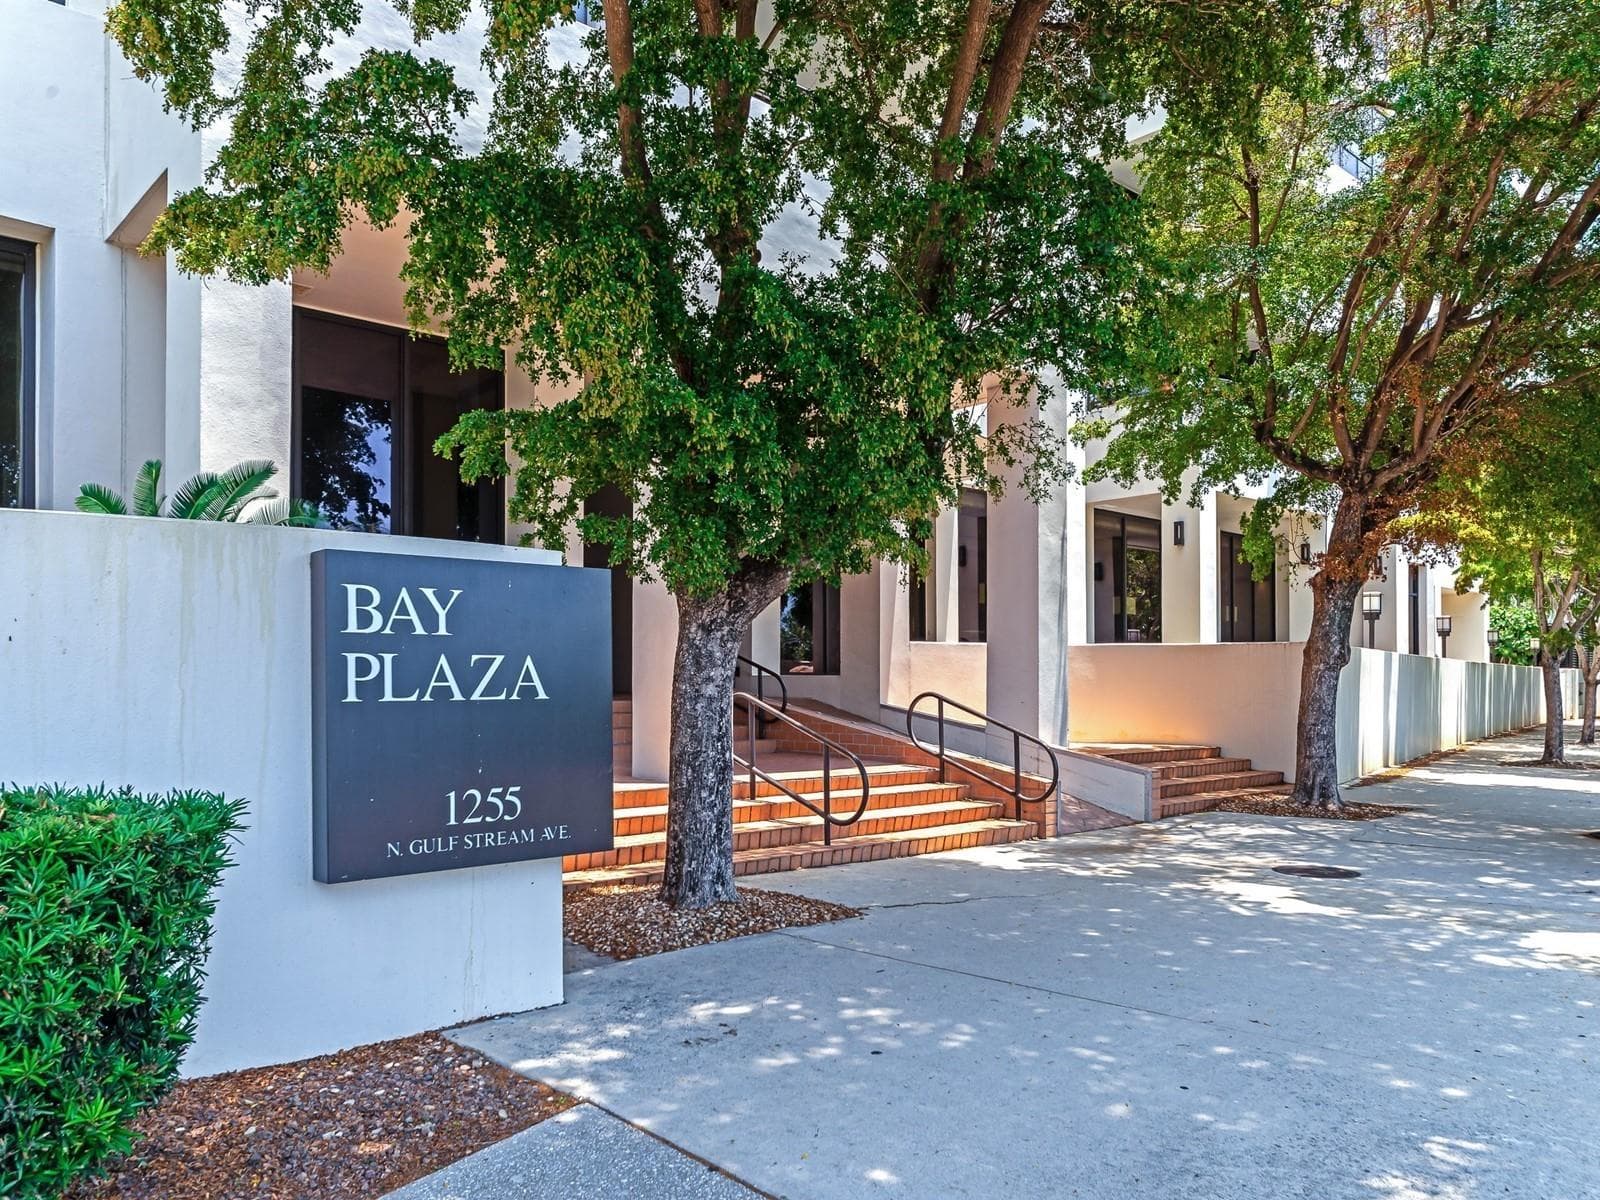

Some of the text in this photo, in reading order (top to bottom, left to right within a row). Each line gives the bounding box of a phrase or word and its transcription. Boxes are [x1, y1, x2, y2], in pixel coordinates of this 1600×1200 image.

[340, 583, 463, 636] BAY
[341, 652, 550, 703] PLAZA
[445, 786, 522, 826] 1255
[386, 824, 572, 858] N. GULF STREAM AVE.
